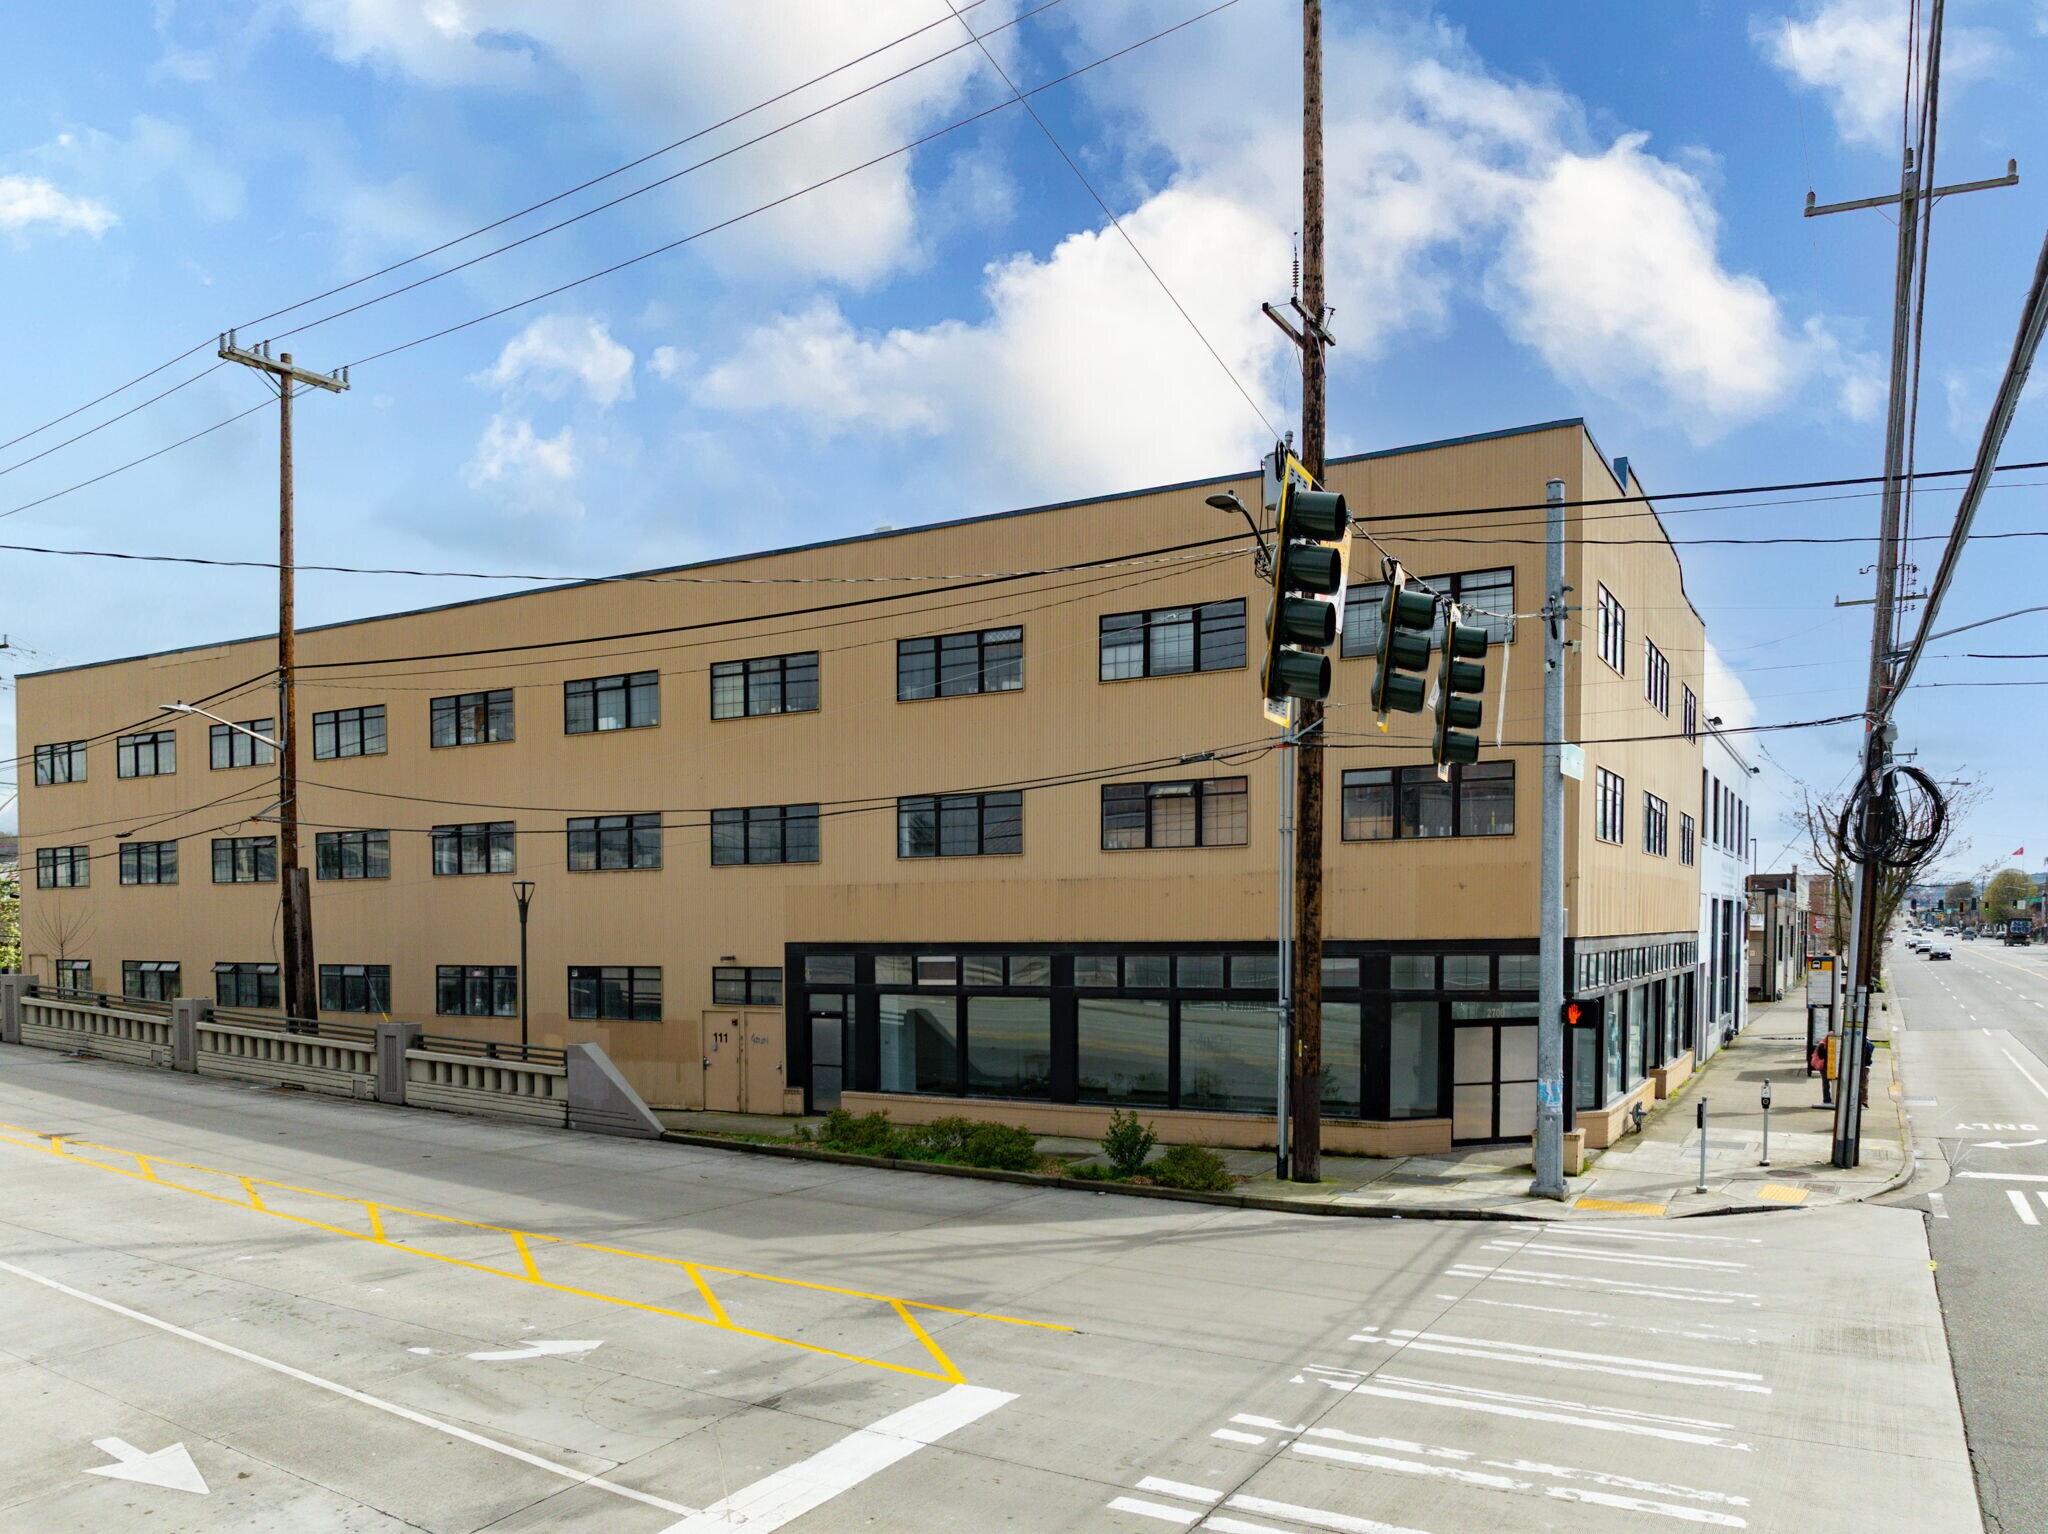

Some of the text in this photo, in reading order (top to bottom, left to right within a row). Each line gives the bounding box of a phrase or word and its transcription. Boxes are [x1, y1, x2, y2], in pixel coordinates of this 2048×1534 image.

[1487, 1008, 1505, 1018] 2700
[713, 1032, 728, 1043] 111
[1954, 1123, 2040, 1131] ONLY
